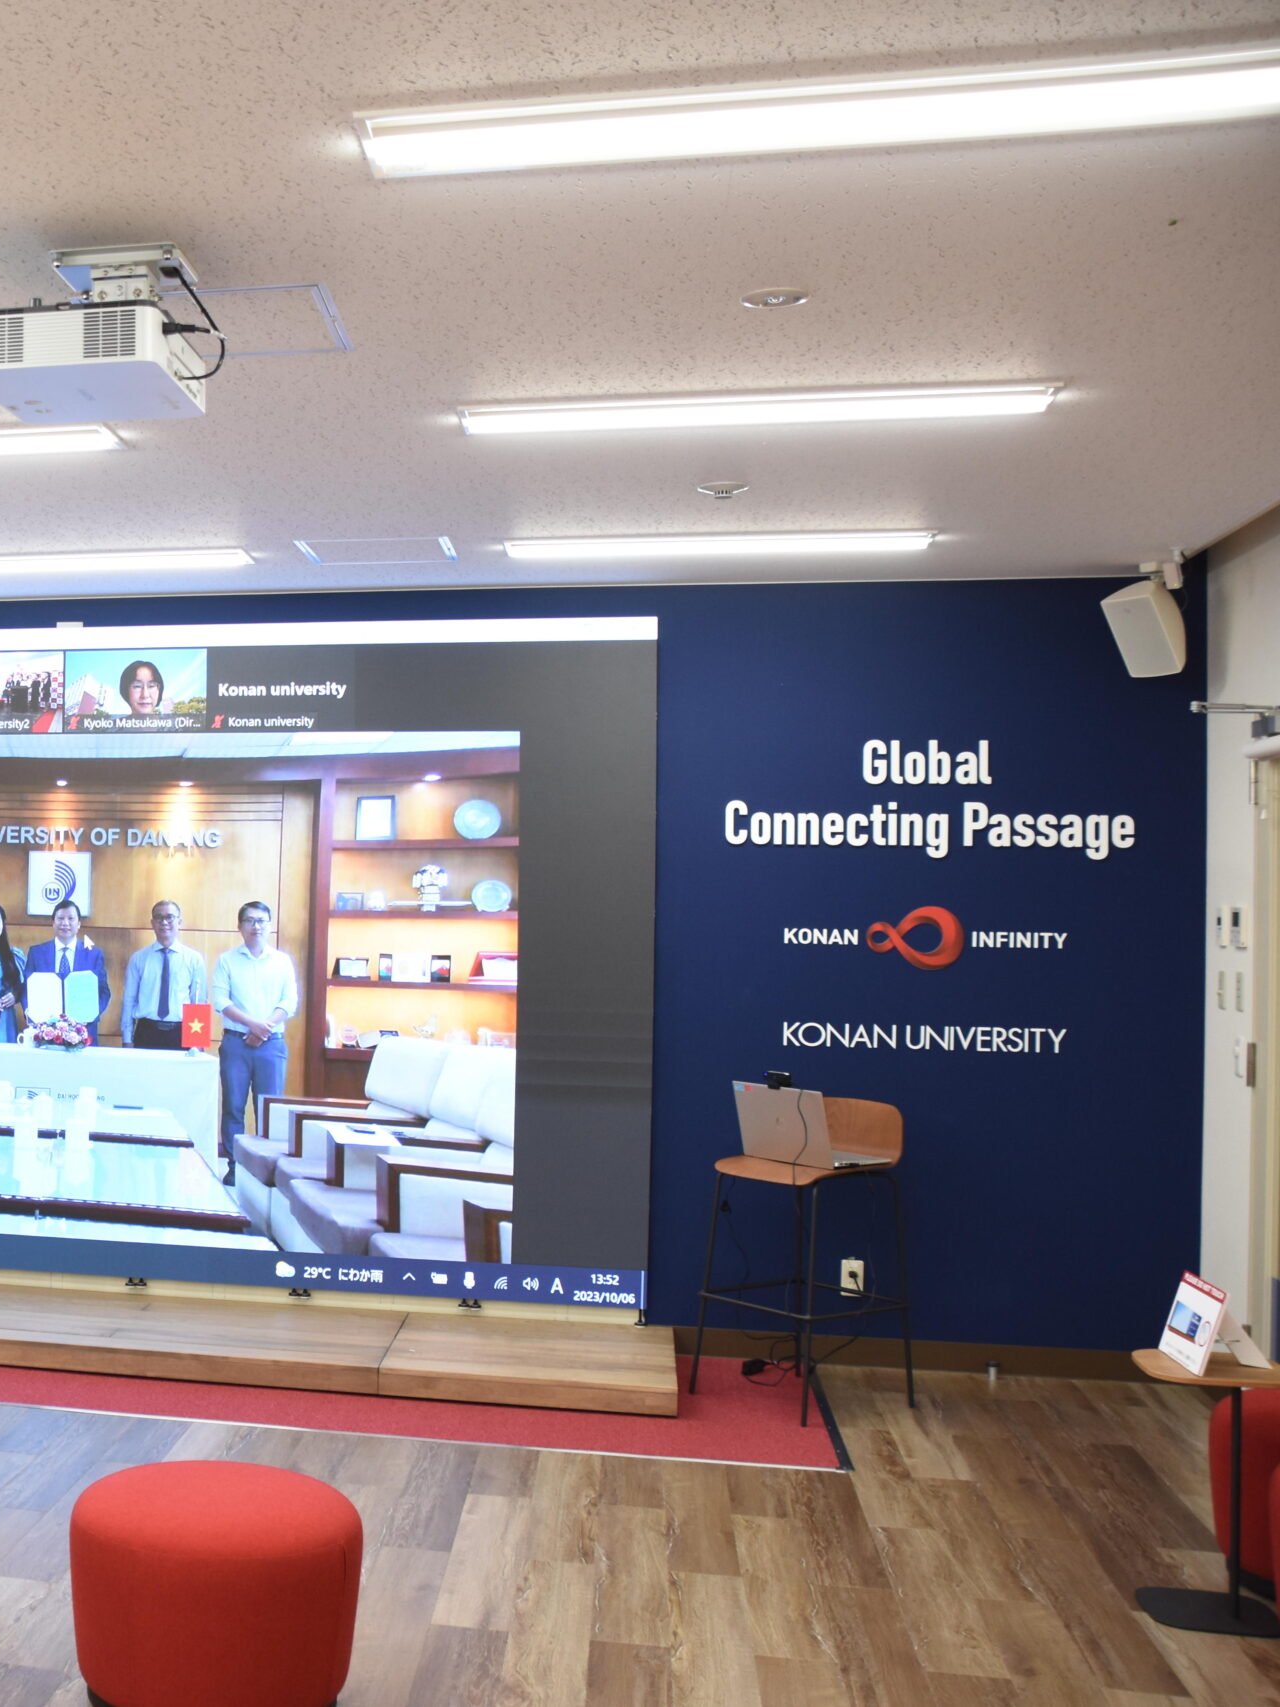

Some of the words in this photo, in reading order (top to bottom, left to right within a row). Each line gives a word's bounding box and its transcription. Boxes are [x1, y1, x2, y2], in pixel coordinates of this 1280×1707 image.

[219, 682, 270, 697] Konan
[271, 681, 347, 699] university
[84, 718, 114, 730] Kyoko
[116, 717, 172, 728] Matsukawa
[228, 717, 263, 727] Konan
[264, 716, 315, 729] university
[862, 739, 993, 786] Global
[91, 827, 121, 847] OF
[127, 828, 222, 849] DANANG
[724, 799, 950, 859] Connecting
[962, 801, 1136, 860] Passage
[783, 927, 859, 946] KONAN
[971, 931, 1068, 949] INFINITY
[782, 1021, 897, 1049] KONAN
[905, 1024, 1068, 1054] UNIVERSITY
[338, 1268, 384, 1284] にわか雨
[591, 1273, 619, 1286] 13:52
[550, 1278, 564, 1295] A
[573, 1290, 636, 1305] 2023/10/06
